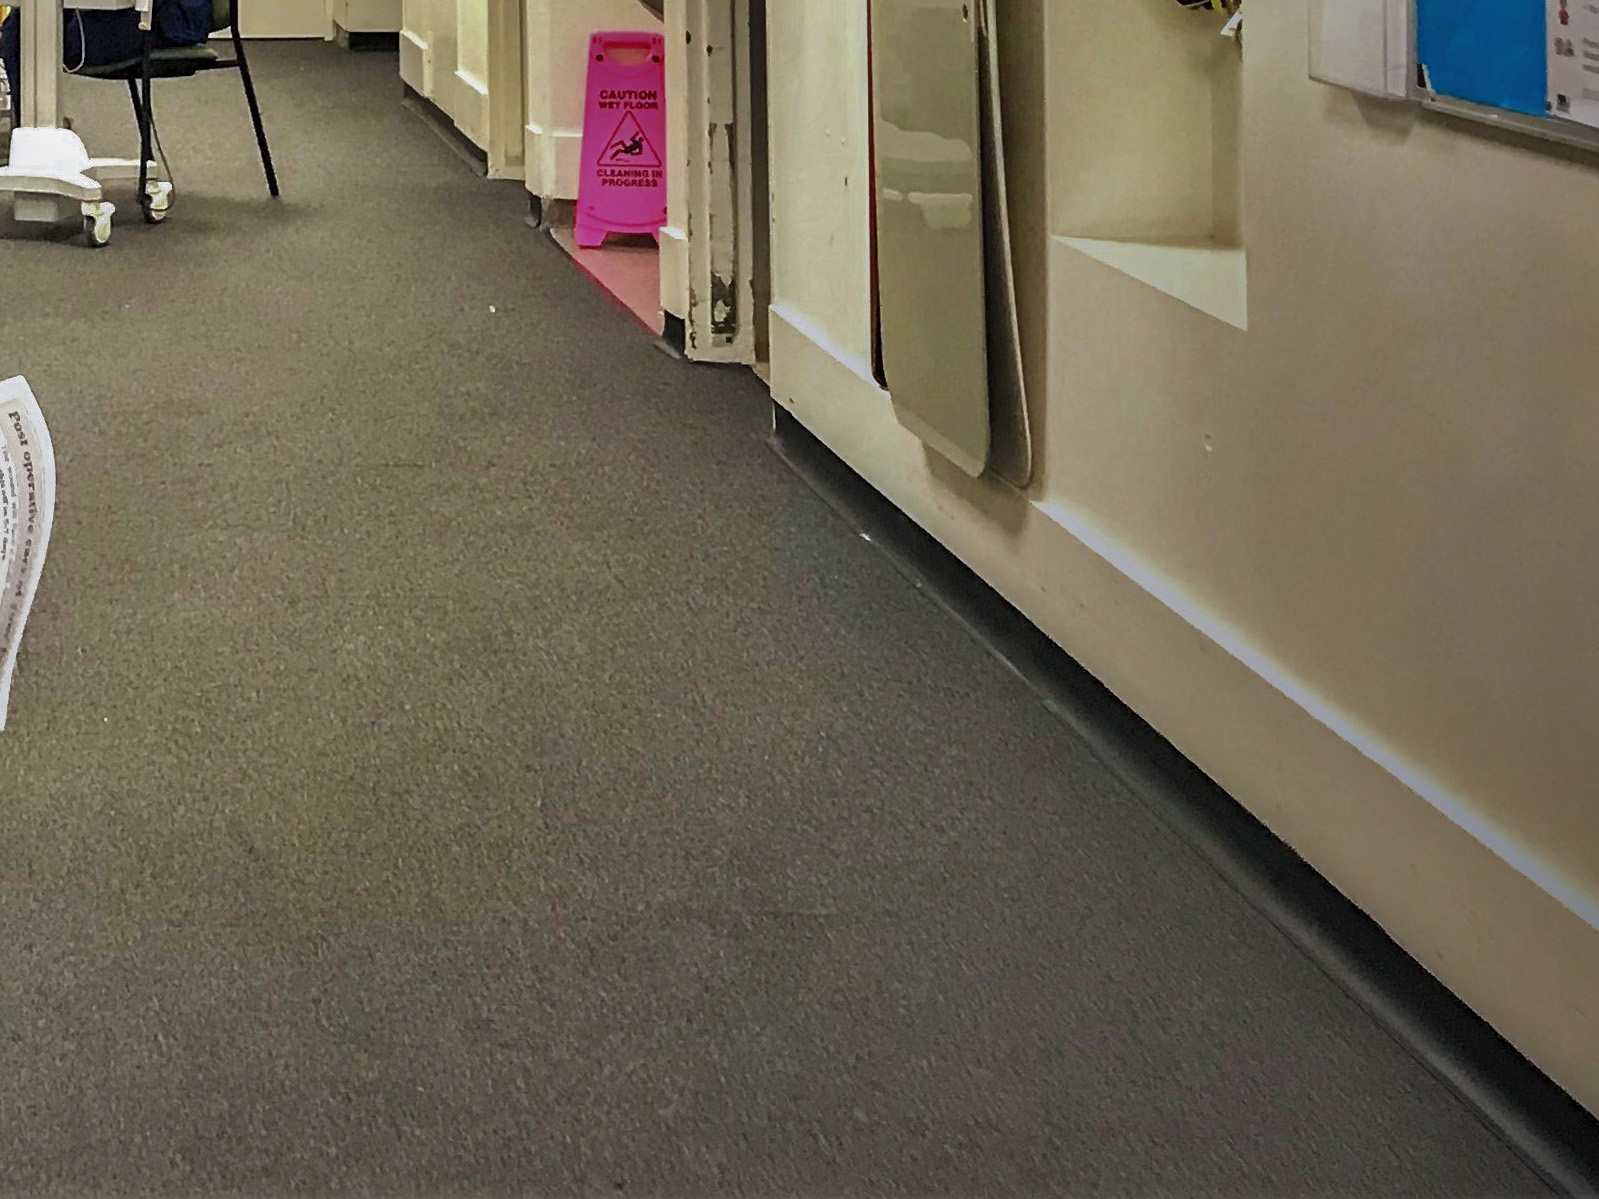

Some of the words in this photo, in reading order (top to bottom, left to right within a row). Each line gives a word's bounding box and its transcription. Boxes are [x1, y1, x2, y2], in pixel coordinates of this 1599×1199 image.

[599, 89, 658, 100] CAUTION
[598, 101, 620, 109] WET
[623, 101, 659, 110] FLOOR
[596, 169, 649, 178] CLEANING
[651, 170, 663, 179] IN
[601, 179, 658, 187] PROGRESS
[9, 411, 29, 446] Post
[23, 451, 39, 534] operative
